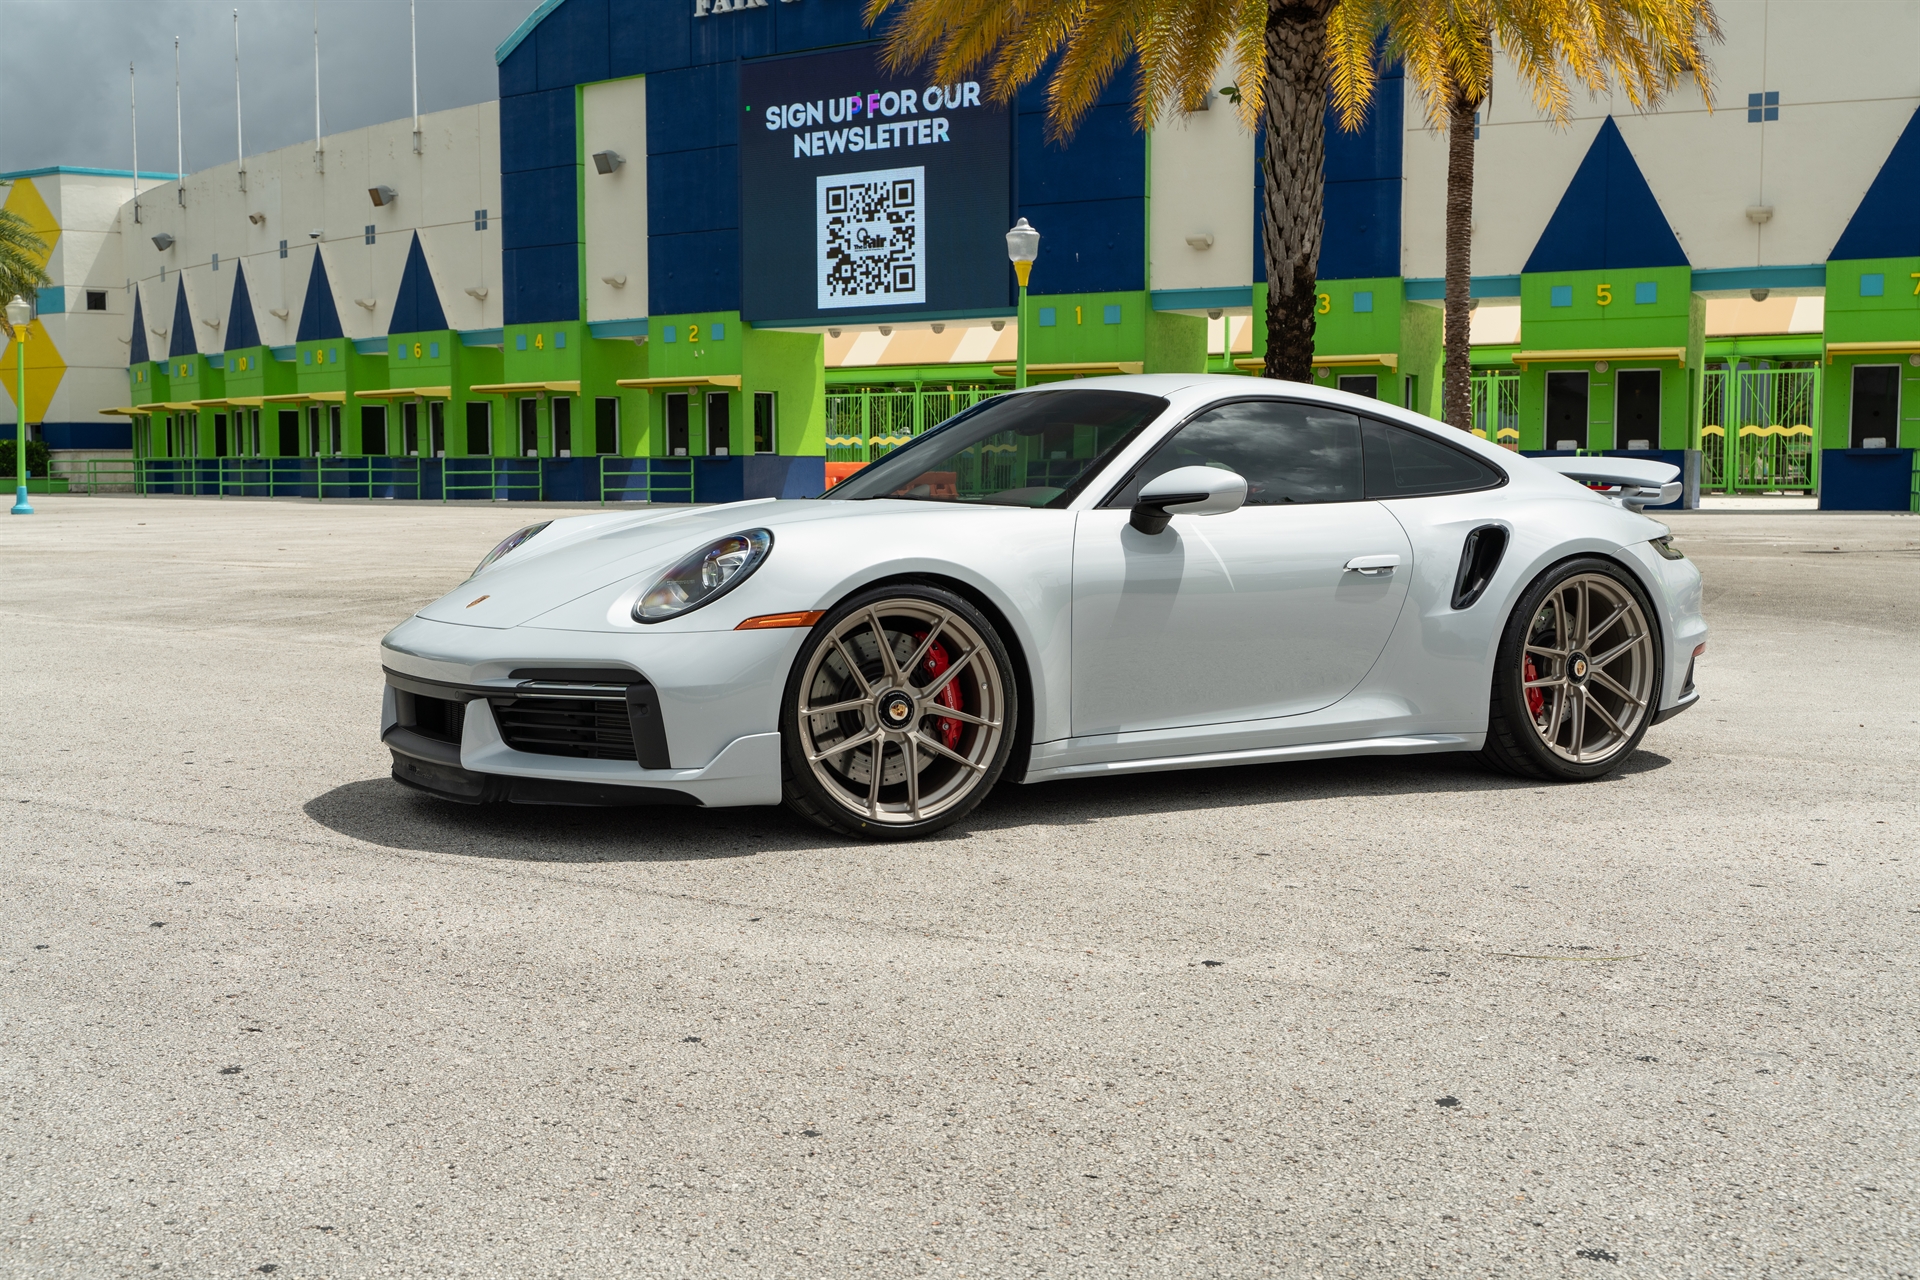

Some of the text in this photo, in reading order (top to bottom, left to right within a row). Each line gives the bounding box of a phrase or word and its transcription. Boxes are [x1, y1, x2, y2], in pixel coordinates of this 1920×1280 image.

[765, 81, 981, 131] SIGN UP FOR OUR
[793, 117, 950, 158] NEWSLETTER
[1596, 284, 1612, 306] 5
[1318, 294, 1331, 315] 3
[1075, 306, 1082, 325] 1
[535, 334, 544, 350] 4
[689, 325, 699, 342] 2
[317, 349, 323, 364] 8
[414, 343, 421, 358] 6
[239, 357, 246, 371] 10
